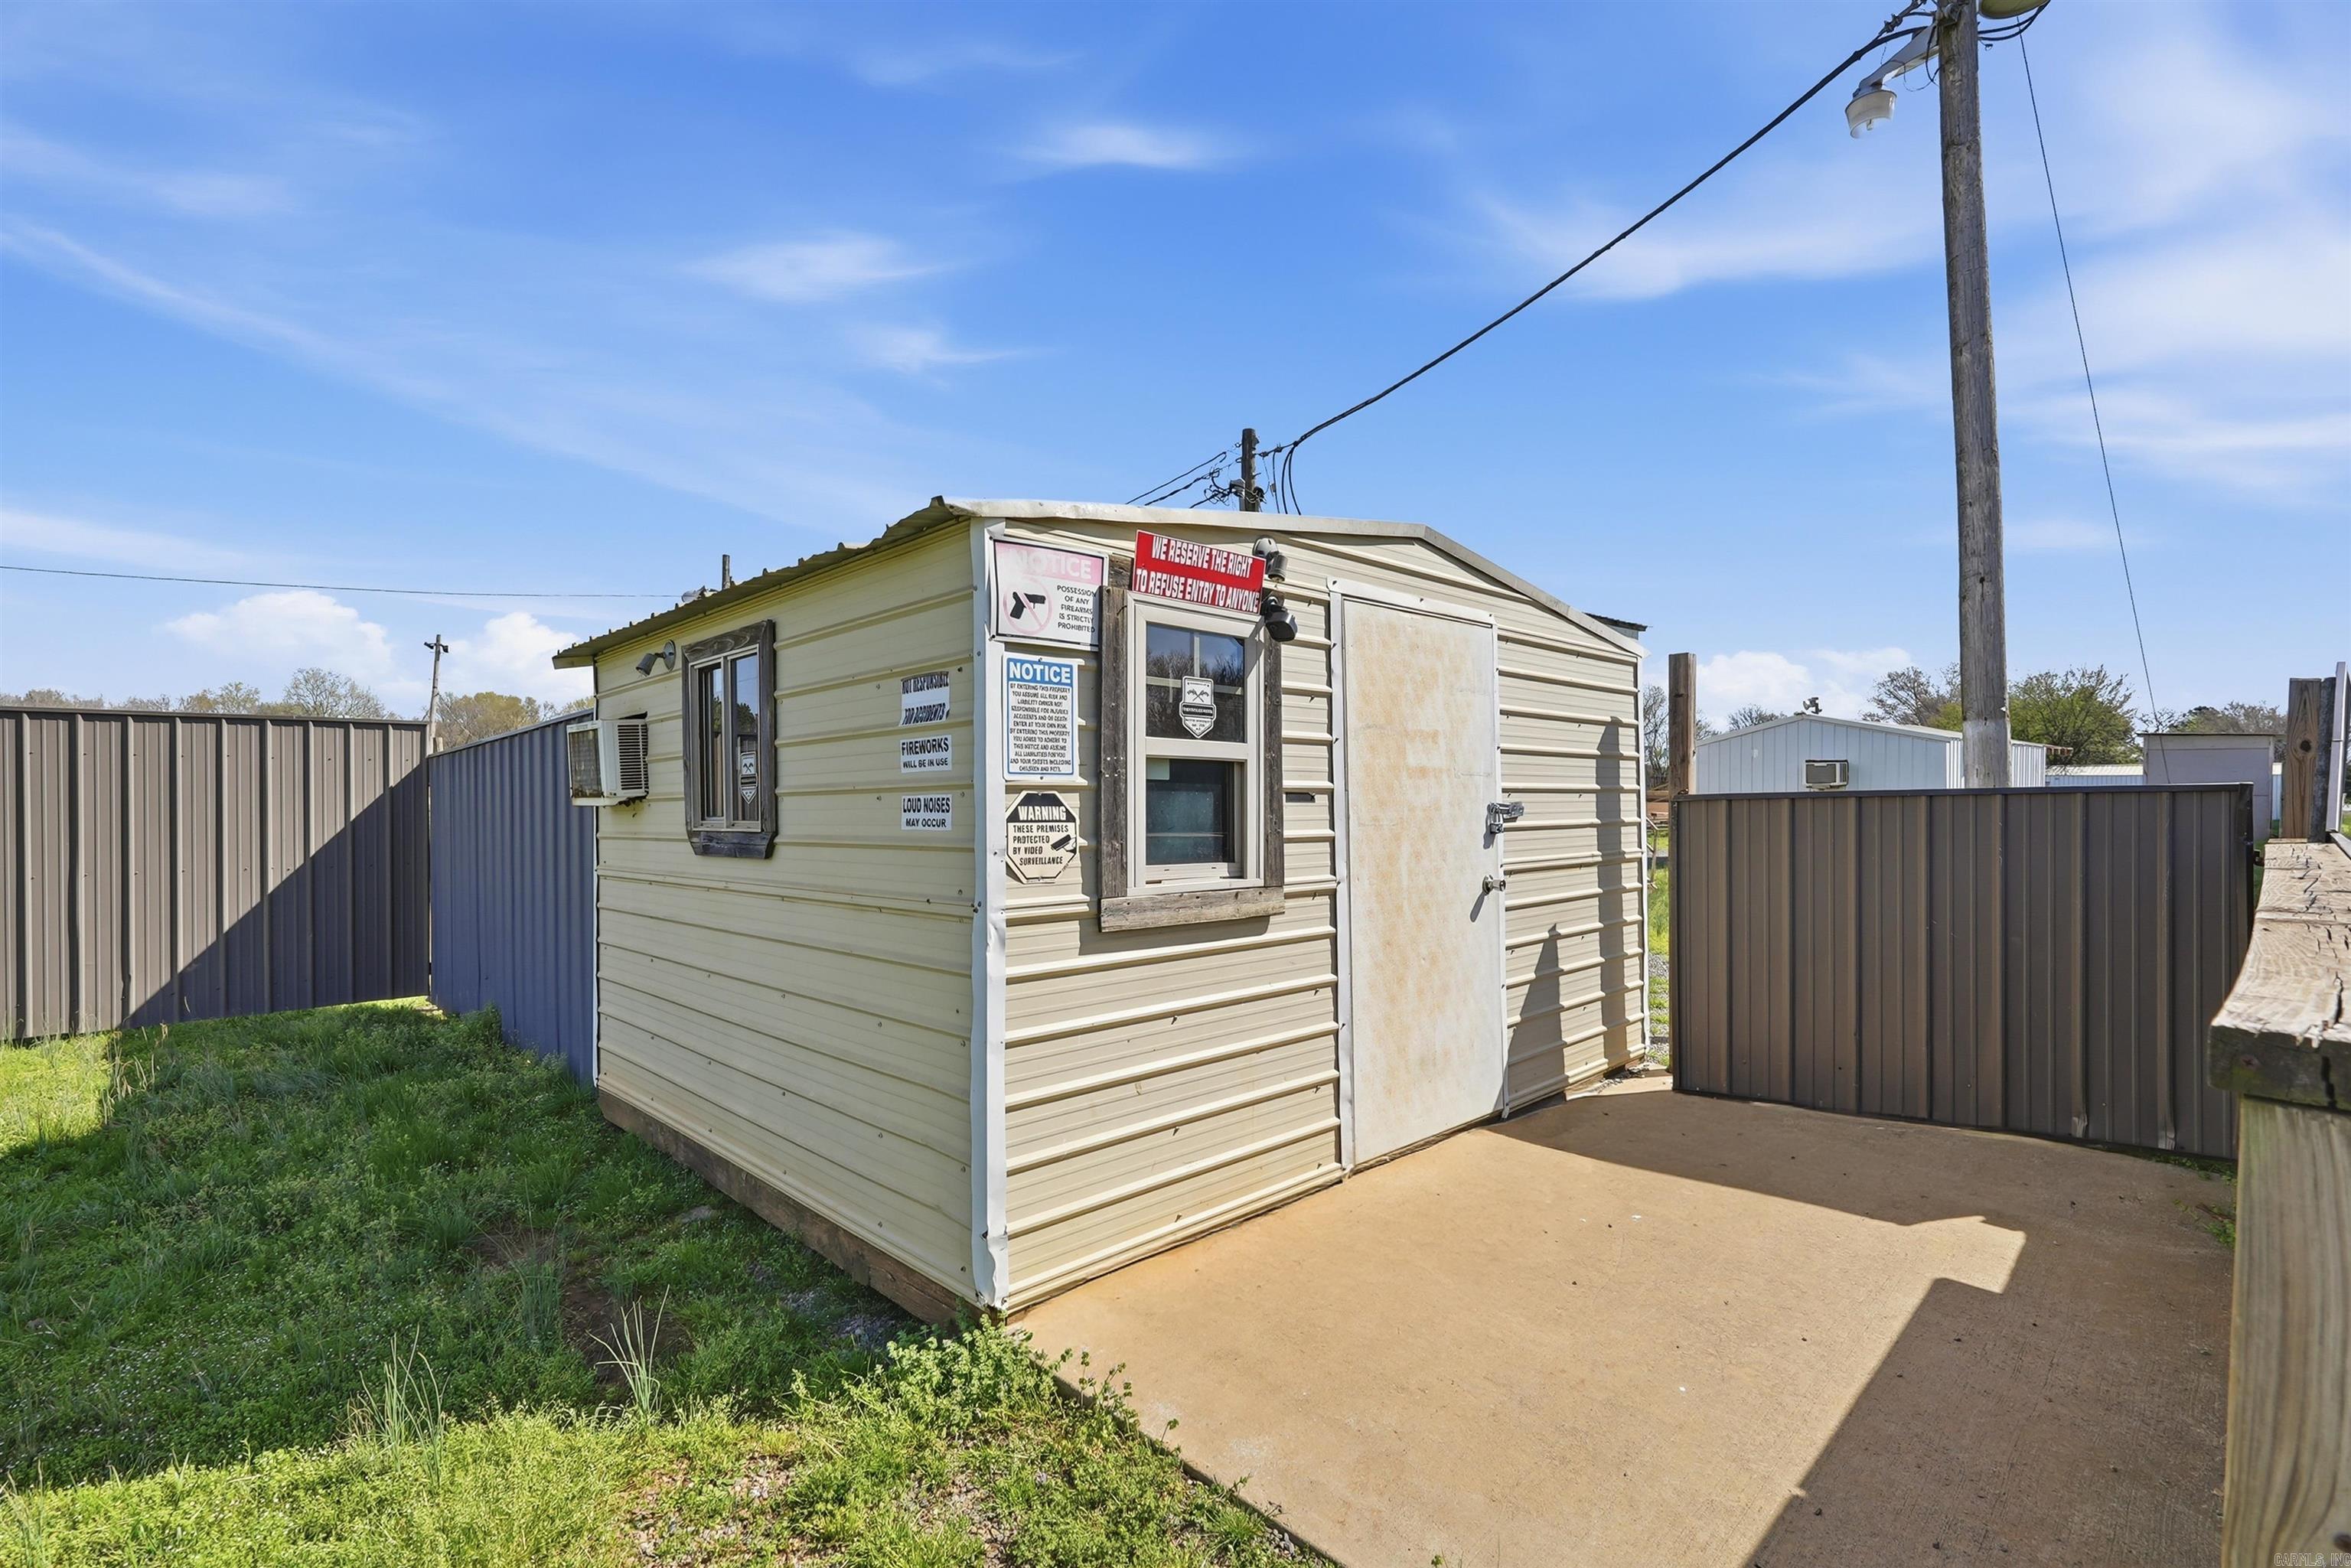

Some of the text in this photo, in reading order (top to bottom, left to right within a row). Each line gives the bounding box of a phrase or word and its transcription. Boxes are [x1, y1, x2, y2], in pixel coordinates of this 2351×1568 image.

[1009, 549, 1091, 579] NOTICE
[1152, 536, 1253, 578] WE RESERVE THE RIGHT
[1057, 585, 1096, 597] POSSESSION
[1136, 569, 1260, 613] TO REFUSE ENTRY TO ANYONE
[1061, 604, 1093, 614] FIREARMS
[1067, 614, 1094, 623] STRICTLY
[1058, 622, 1094, 633] PROHIBITED
[1009, 661, 1071, 683] NOTICE
[902, 680, 911, 694] NOT
[902, 708, 915, 725] FOR
[902, 737, 949, 756] FIREWORKS
[918, 759, 926, 768] BE
[937, 758, 947, 766] USE
[903, 797, 950, 813] LOUD NOISES
[1018, 806, 1066, 820] WARNING
[906, 818, 946, 827] MAY OCCUR
[1019, 856, 1062, 865] SURVEILLANCE
